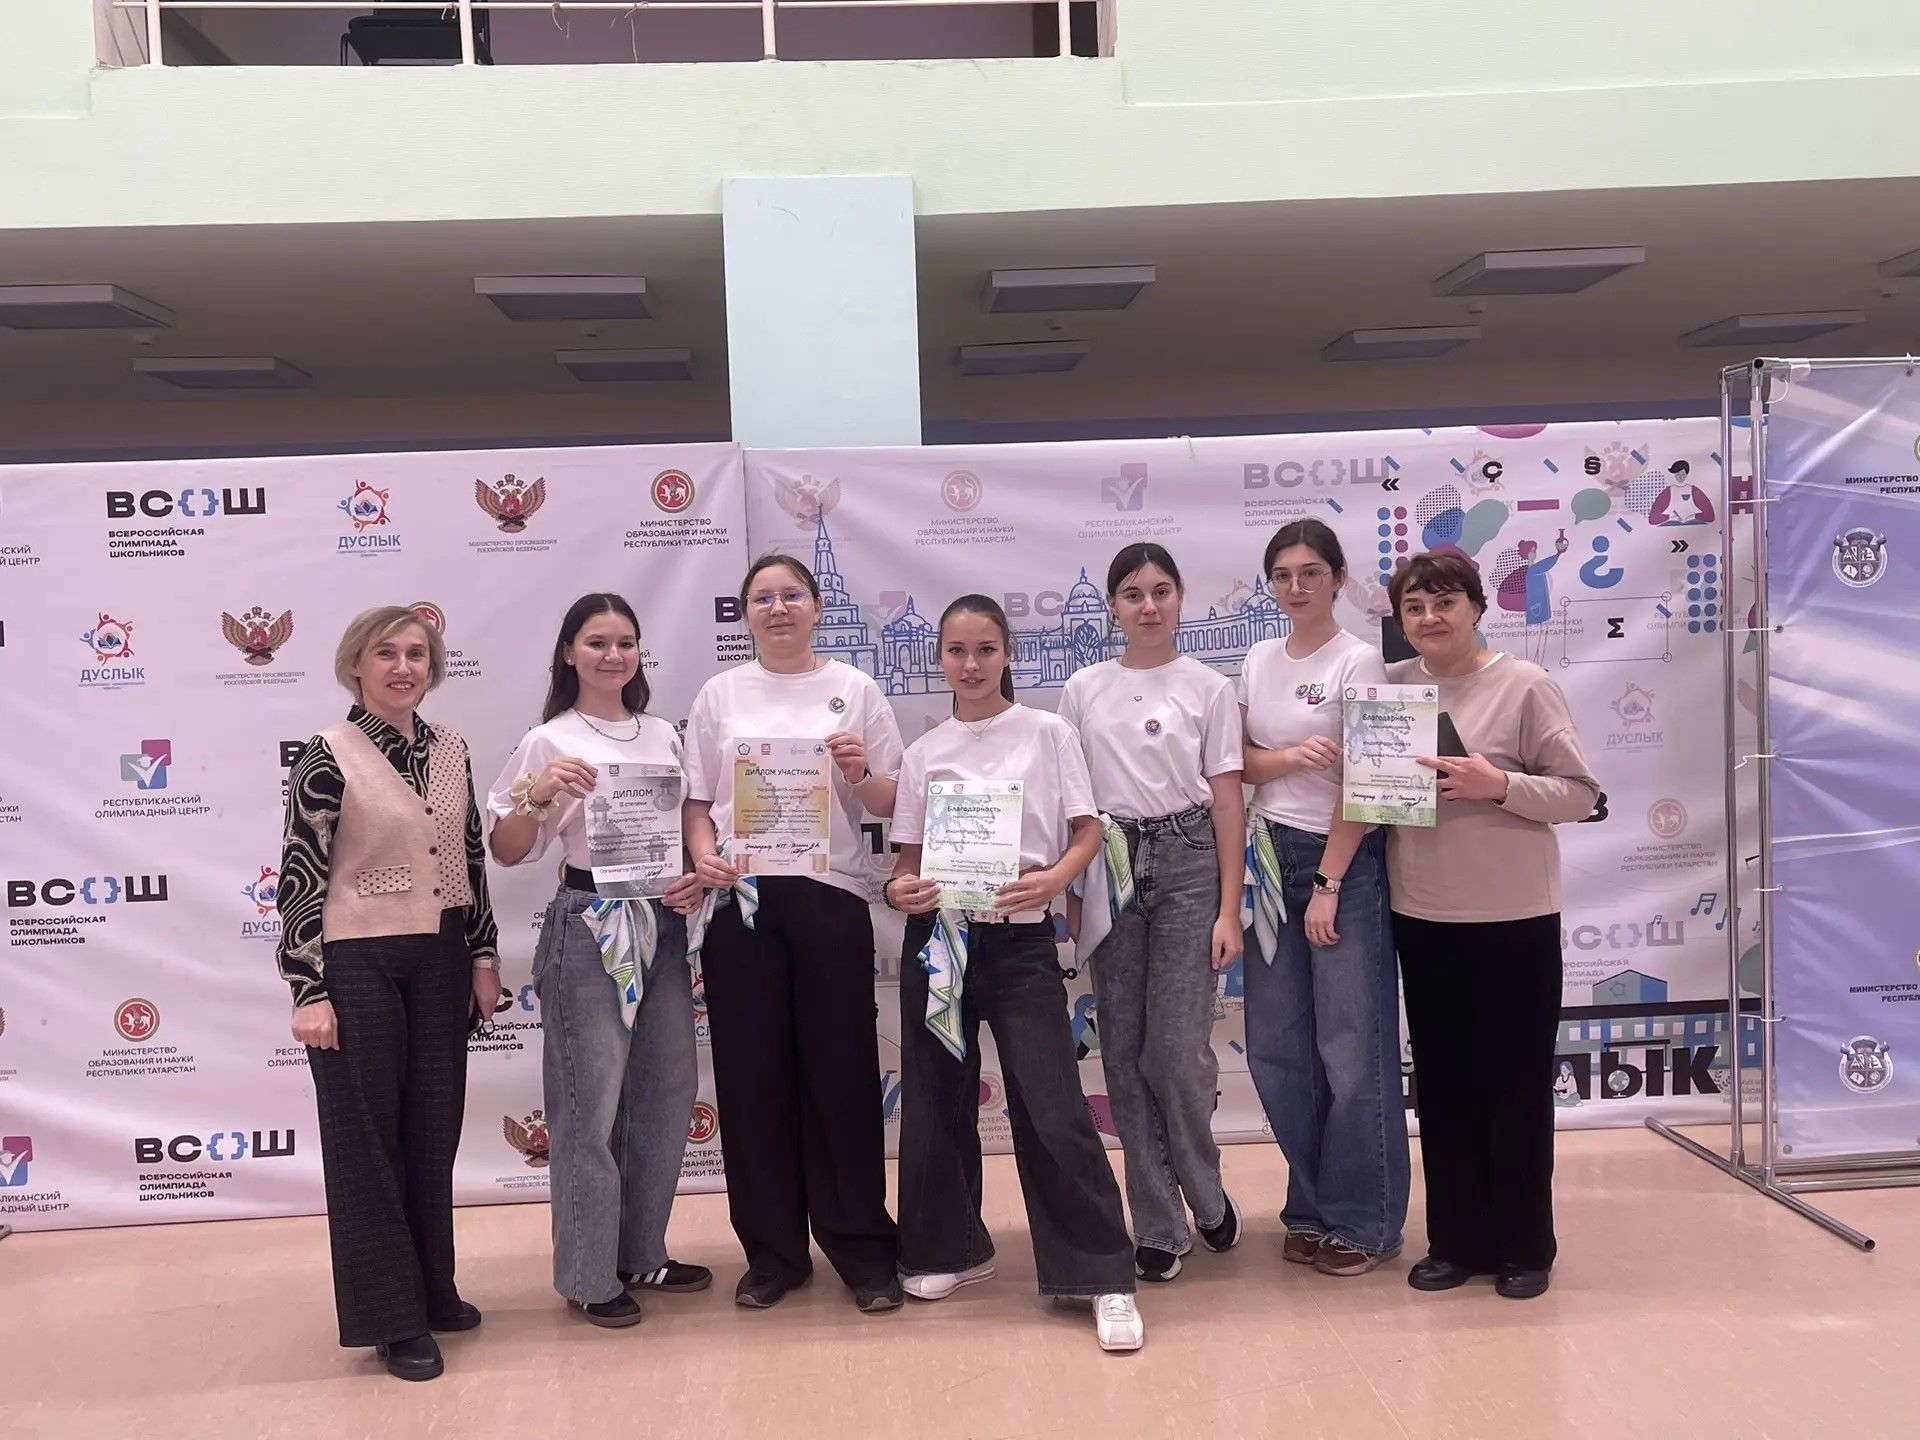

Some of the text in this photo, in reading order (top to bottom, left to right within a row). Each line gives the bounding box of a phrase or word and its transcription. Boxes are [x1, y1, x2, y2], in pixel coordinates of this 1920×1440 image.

[1845, 475, 1920, 484] МИНИСТЕРСТВО
[1244, 508, 1307, 518] ОЛИМПИАДА
[640, 517, 712, 528] МИНИСТЕРСТВО
[930, 517, 1000, 527] МИНИСТЕРСТВО
[1084, 515, 1174, 529] РЕСПУБЛИКАНСКИЙ
[108, 527, 205, 538] ВСЕРОССИЙСКАЯ
[625, 528, 689, 539] ОБРАЗОВАНИЯ
[699, 526, 728, 536] НАУКИ
[916, 526, 976, 537] ОБРАЗОВАНИЯ
[986, 526, 1015, 535] НАУКИ
[1077, 525, 1183, 540] ОЛИМПИАДНЫЙ ЦЕНТР
[109, 538, 178, 549] ОЛИМПИАДА
[338, 535, 401, 550] ДУСЛЫК
[623, 536, 730, 549] РЕСПУБЛИКИ ТАТАРСТАН
[914, 534, 1016, 547] РЕСПУБЛИКИ ТАТАРСТАН
[109, 549, 186, 559] ШКОЛЬНИКОВ
[8, 556, 41, 566] ЦЕНТР
[80, 667, 146, 683] ДУСЛЫК
[446, 670, 482, 678] АРСТАН
[1362, 713, 1416, 722] Благодарность
[1606, 731, 1663, 746] ДУСЛЫК
[745, 767, 820, 777] ДИПЛОМ УЧАСТНИКА
[612, 788, 654, 800] ДИПЛОМ
[102, 793, 202, 807] РЕСПУБЛИКАНСКИЙ
[95, 805, 211, 819] ОЛИМПИАДНЫЙ ЦЕНТР
[947, 805, 1002, 813] Благодарность
[1635, 842, 1703, 853] МИНИСТЕРСТВО
[1622, 852, 1681, 863] ОБРАЗОВАНИЯ
[1688, 850, 1716, 860] НАУКИ
[1620, 860, 1718, 873] РЕСПУБЛИКИ ТАТАРСТАН
[10, 914, 107, 926] ВСЕРОССИЙСКАЯ
[10, 926, 78, 936] ОЛИМПИАДА
[11, 936, 86, 946] ШКОЛЬНИКОВ
[1849, 983, 1919, 993] МИНИСТЕРСТВО
[103, 1046, 178, 1057] МИНИСТЕРСТВО
[87, 1055, 194, 1068] ОБРАЗОВАНИЯ И НАУКИ
[86, 1065, 197, 1078] РЕСПУБЛИКИ ТАТАРСТАН
[139, 1171, 233, 1182] ВСЕРОССИЙСКАЯ
[139, 1181, 208, 1191] ОЛИМПИАДА
[139, 1190, 215, 1202] ШКОЛЬНИКОВ
[38, 1203, 70, 1213] ЦЕНТР
